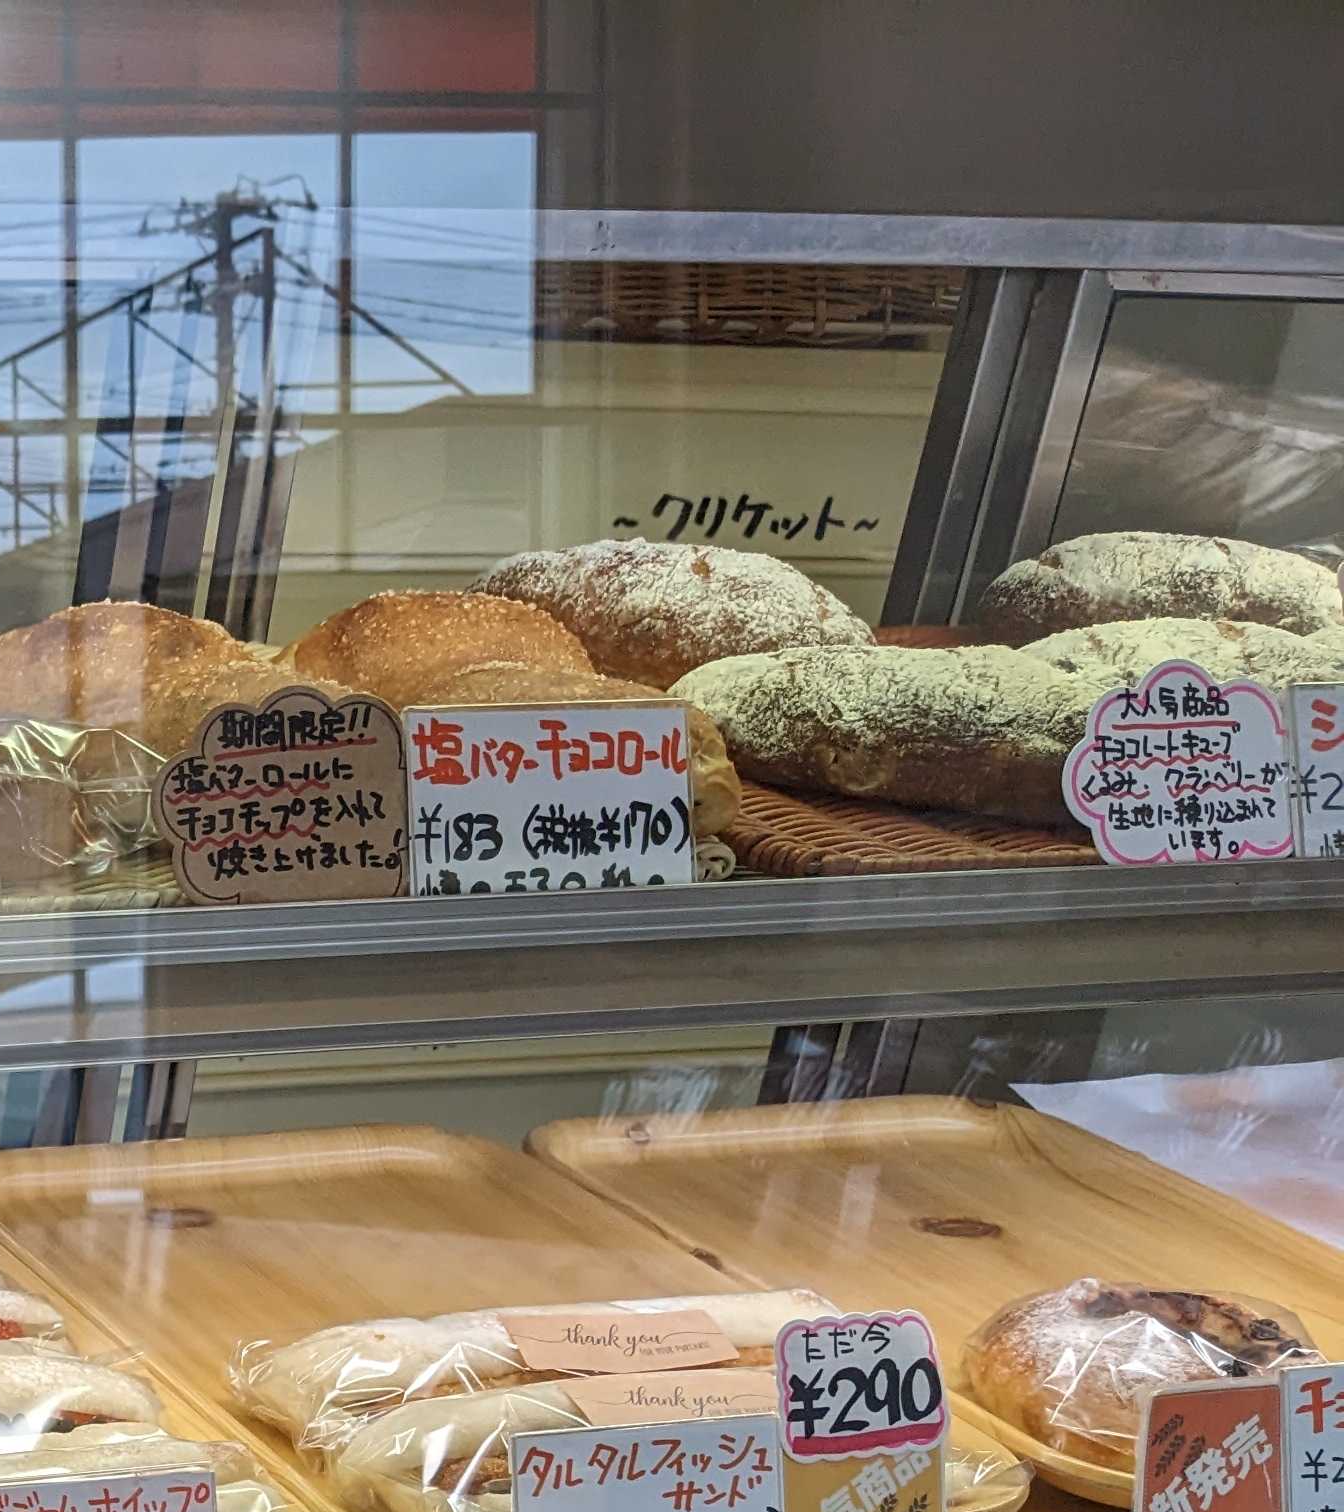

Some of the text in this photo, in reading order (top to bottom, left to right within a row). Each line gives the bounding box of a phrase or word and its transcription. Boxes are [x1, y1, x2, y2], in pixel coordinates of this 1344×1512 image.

[1117, 682, 1230, 719] 大人気商品
[414, 718, 688, 786] 塩バターチョコロール
[415, 804, 504, 863] ¥183
[564, 1324, 664, 1356] thank you
[802, 1321, 891, 1364] ただ今
[627, 1386, 730, 1416] thank you
[787, 1357, 944, 1440] ¥290
[1296, 1377, 1344, 1434] チ
[517, 1433, 774, 1497] タルタルフィッシュ
[662, 1475, 764, 1512] サンド
